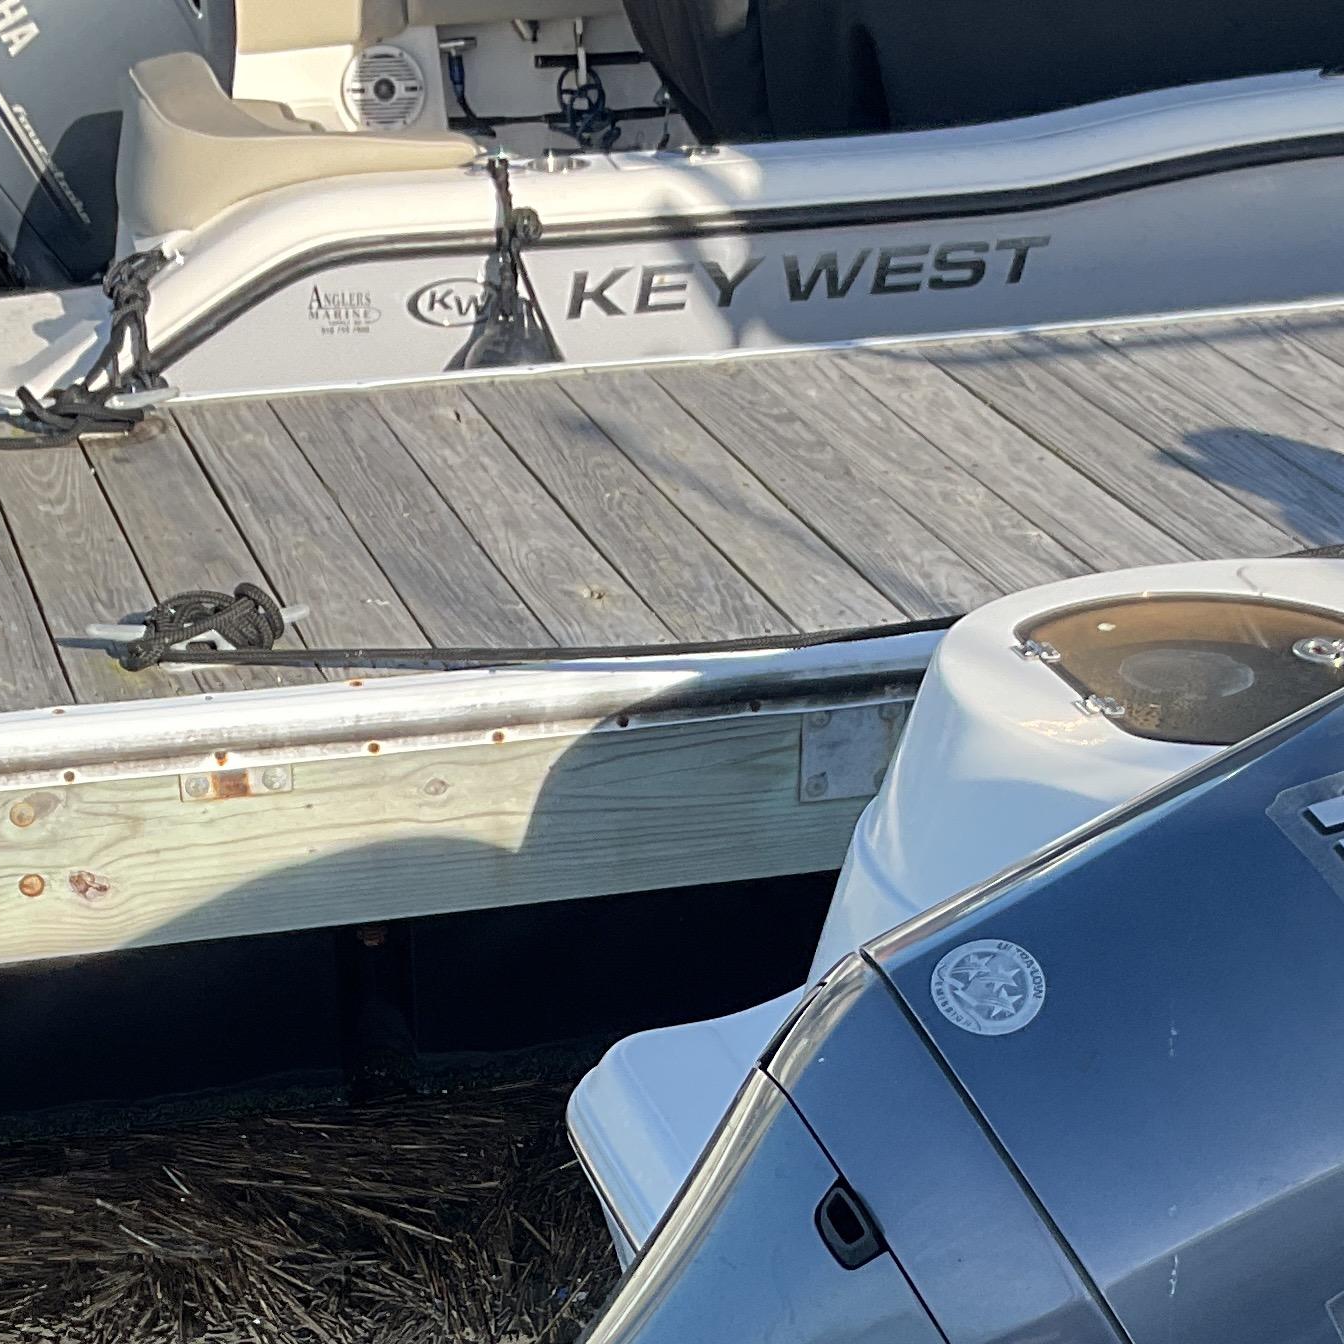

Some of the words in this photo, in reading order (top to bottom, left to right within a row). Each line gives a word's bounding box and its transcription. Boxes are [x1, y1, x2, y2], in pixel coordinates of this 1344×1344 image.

[566, 256, 766, 320] KEY
[782, 235, 1052, 303] WEST
[308, 284, 372, 309] ANGLERS
[427, 288, 493, 316] KW
[308, 308, 369, 320] MARINE
